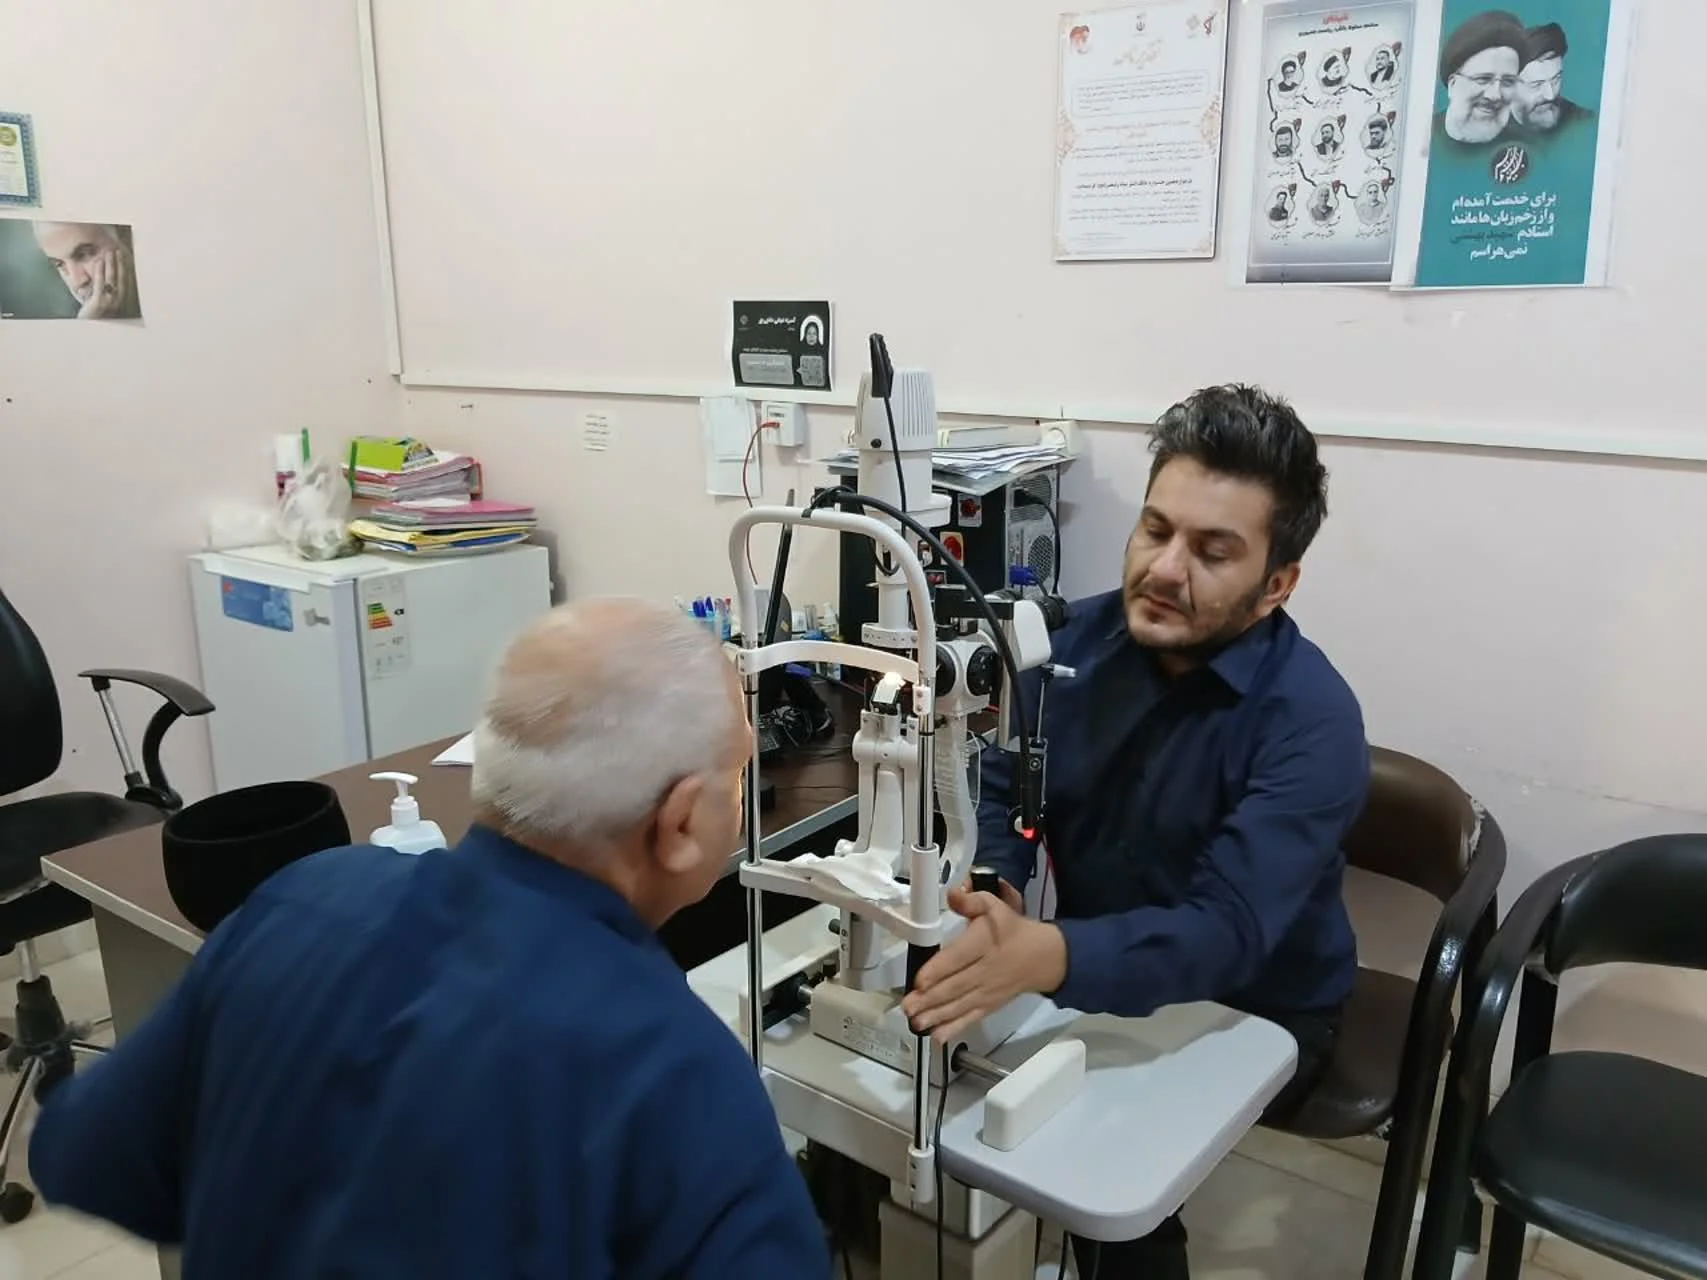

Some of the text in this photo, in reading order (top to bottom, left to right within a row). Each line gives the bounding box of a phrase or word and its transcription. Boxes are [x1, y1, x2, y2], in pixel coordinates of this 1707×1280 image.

[1492, 191, 1529, 206] خدمت
[1530, 191, 1557, 207] برای
[1450, 211, 1480, 225] مانند
[1517, 224, 1554, 241] استادم
